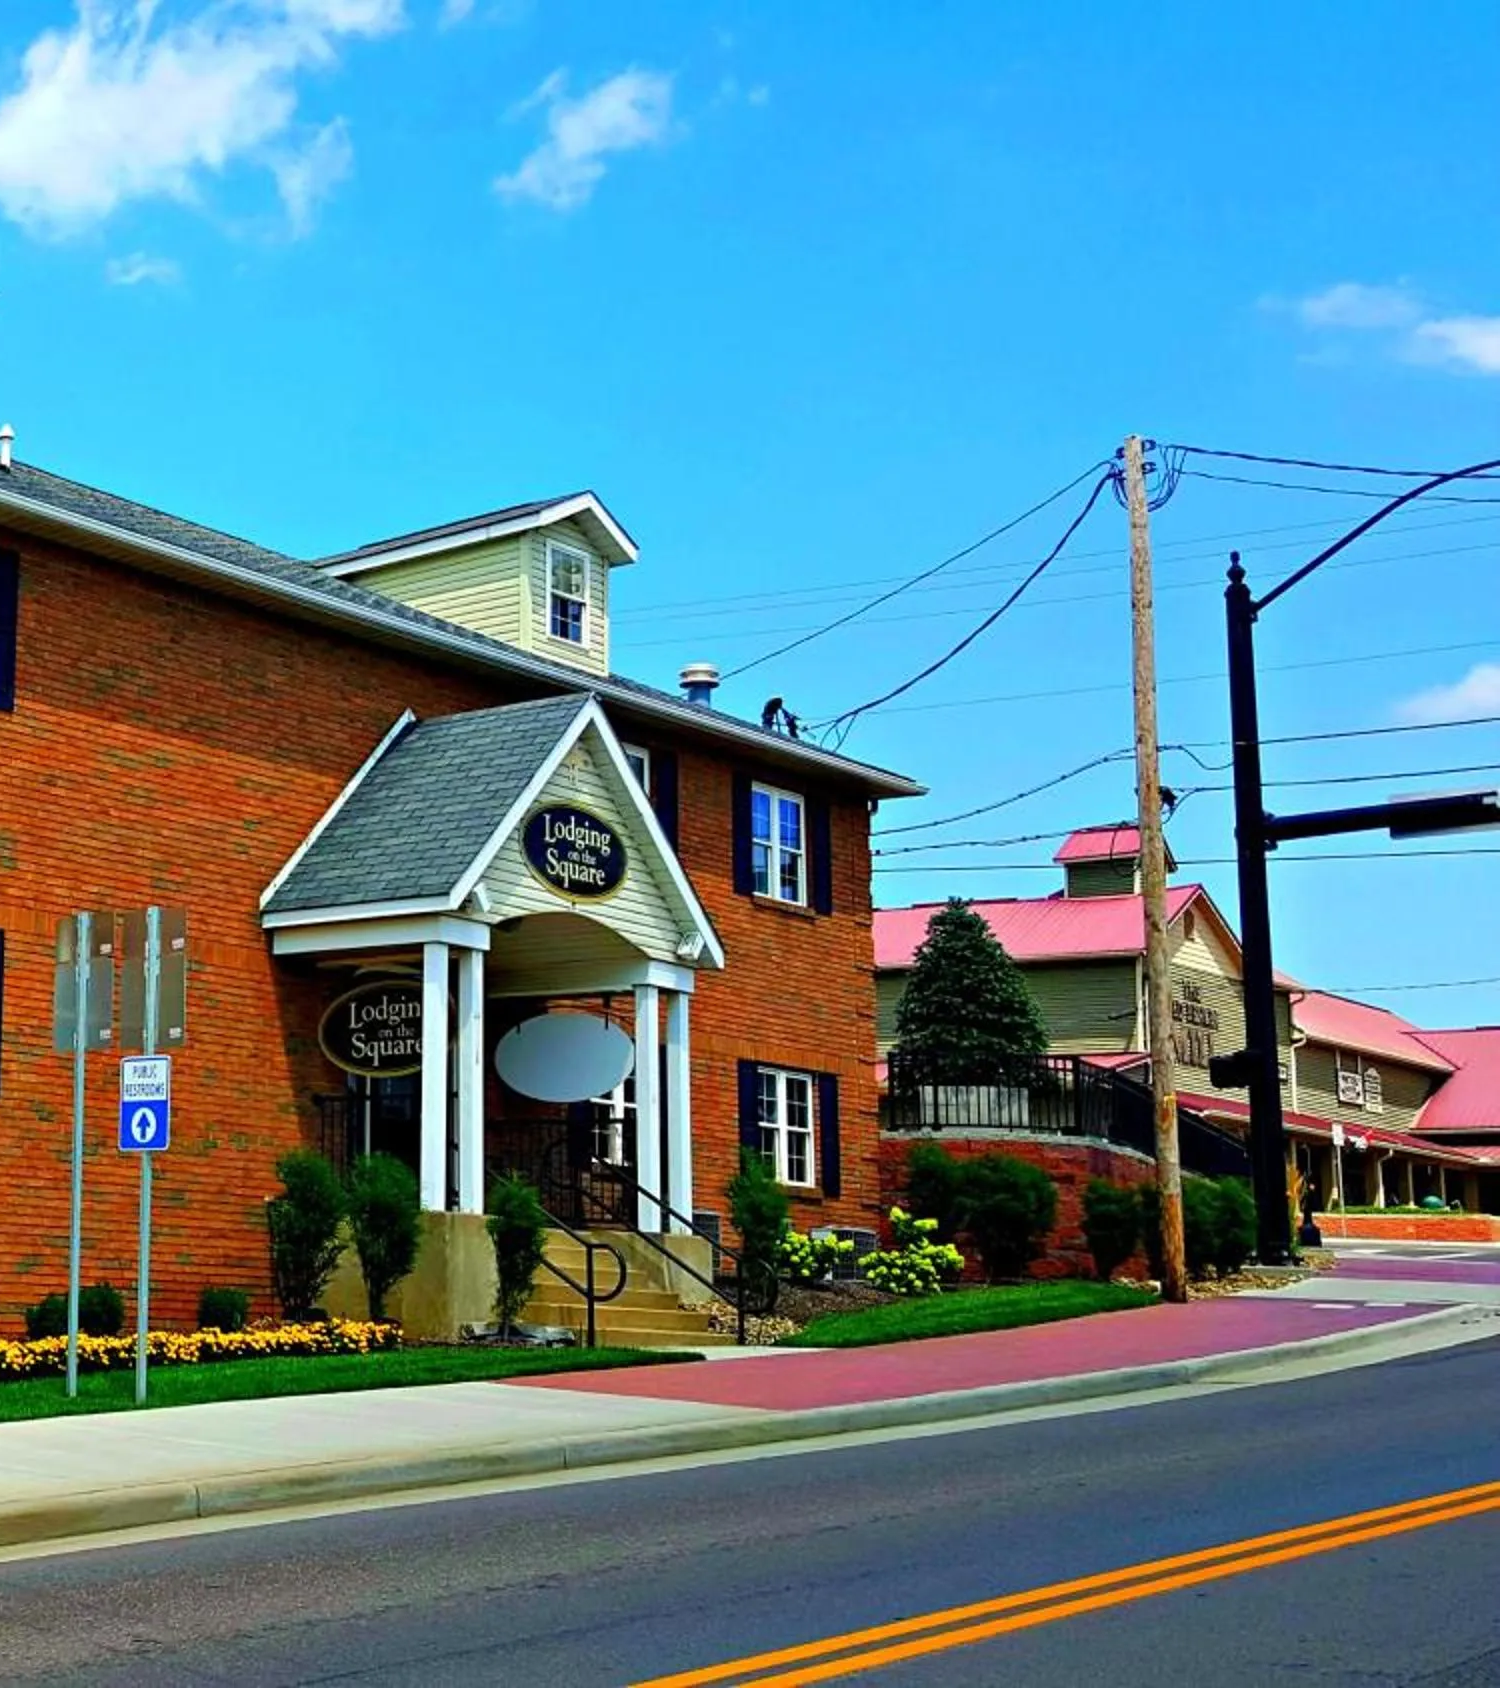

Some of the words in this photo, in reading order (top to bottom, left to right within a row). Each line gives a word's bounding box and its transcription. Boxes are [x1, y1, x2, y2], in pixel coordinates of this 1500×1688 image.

[543, 813, 611, 857] Lodging
[567, 851, 580, 861] on
[582, 849, 597, 865] the
[545, 848, 606, 889] Square
[349, 995, 422, 1029] Lodgin
[378, 1029, 393, 1038] on
[396, 1023, 415, 1037] the
[132, 1063, 157, 1079] PUBLIC
[125, 1082, 165, 1097] RESTROOMS
